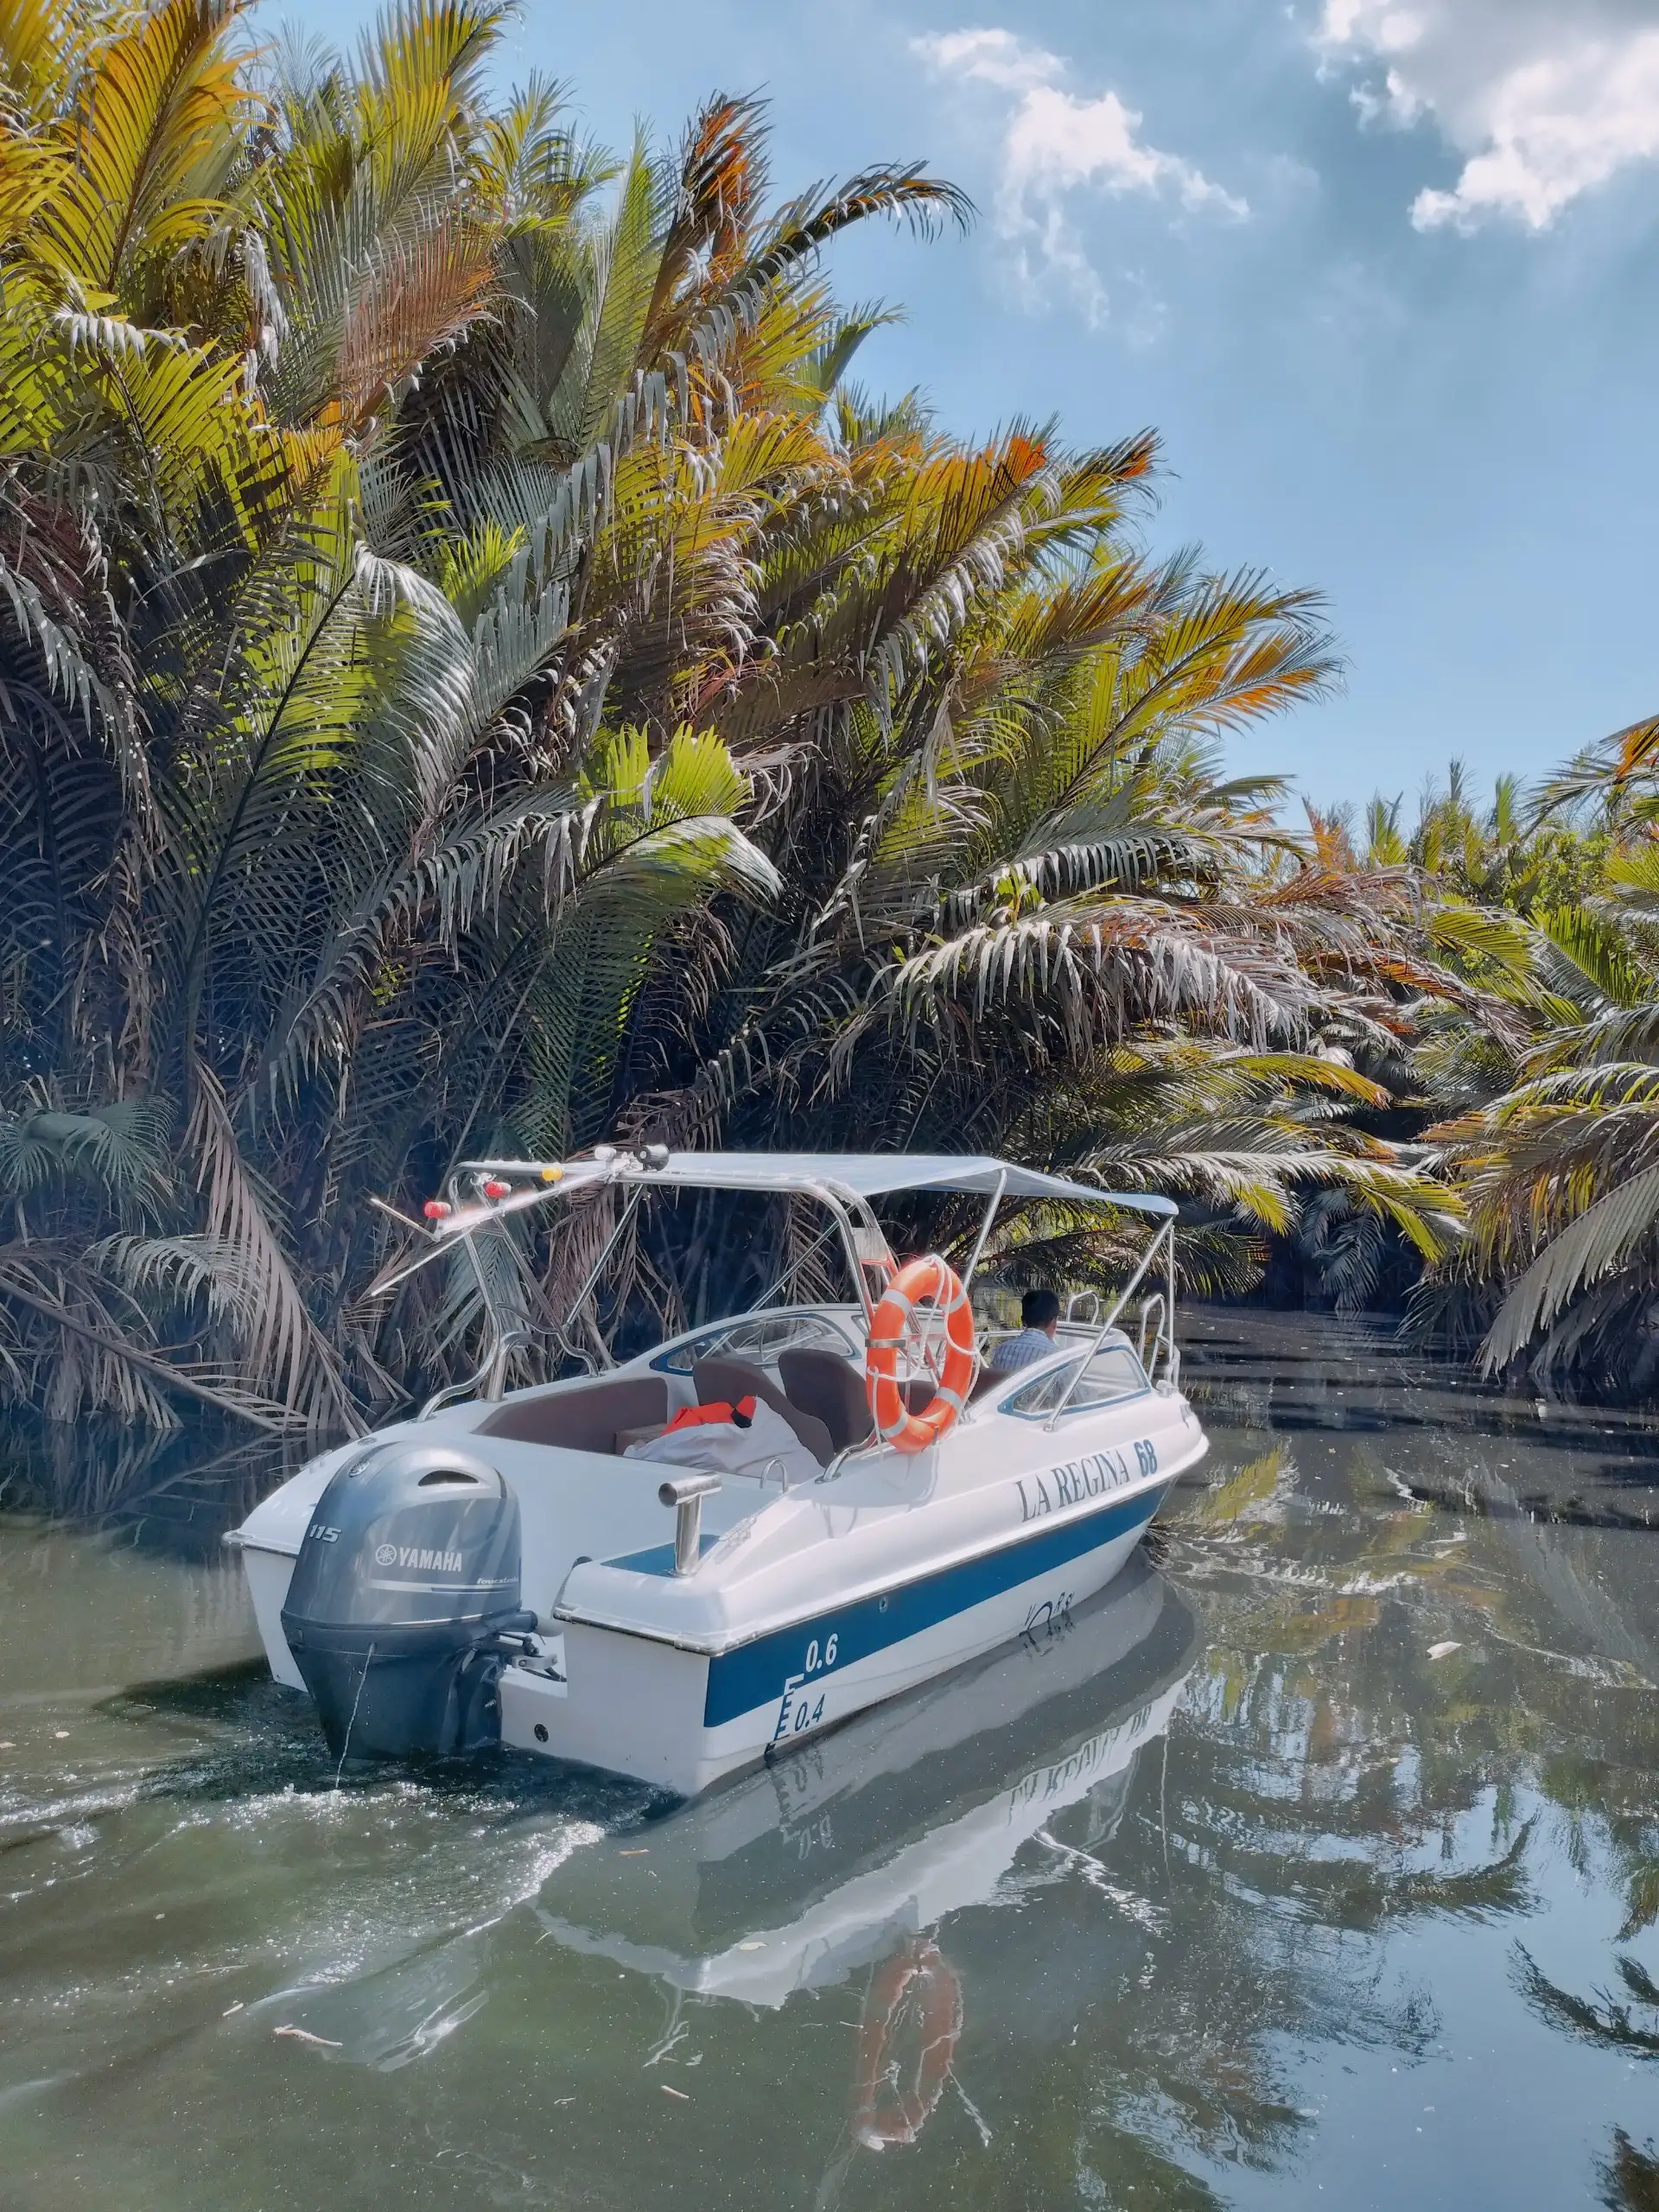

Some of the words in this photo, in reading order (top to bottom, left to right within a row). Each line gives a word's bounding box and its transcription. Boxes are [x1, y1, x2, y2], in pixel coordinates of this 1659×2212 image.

[1015, 1473, 1052, 1522] LA
[1051, 1448, 1130, 1509] REGINA
[1134, 1439, 1158, 1478] 68
[309, 1523, 342, 1543] 115
[399, 1547, 462, 1573] YAMAHA
[476, 1575, 519, 1585] fourstrok
[805, 1633, 838, 1672] 0.6
[795, 1694, 825, 1732] 0.4
